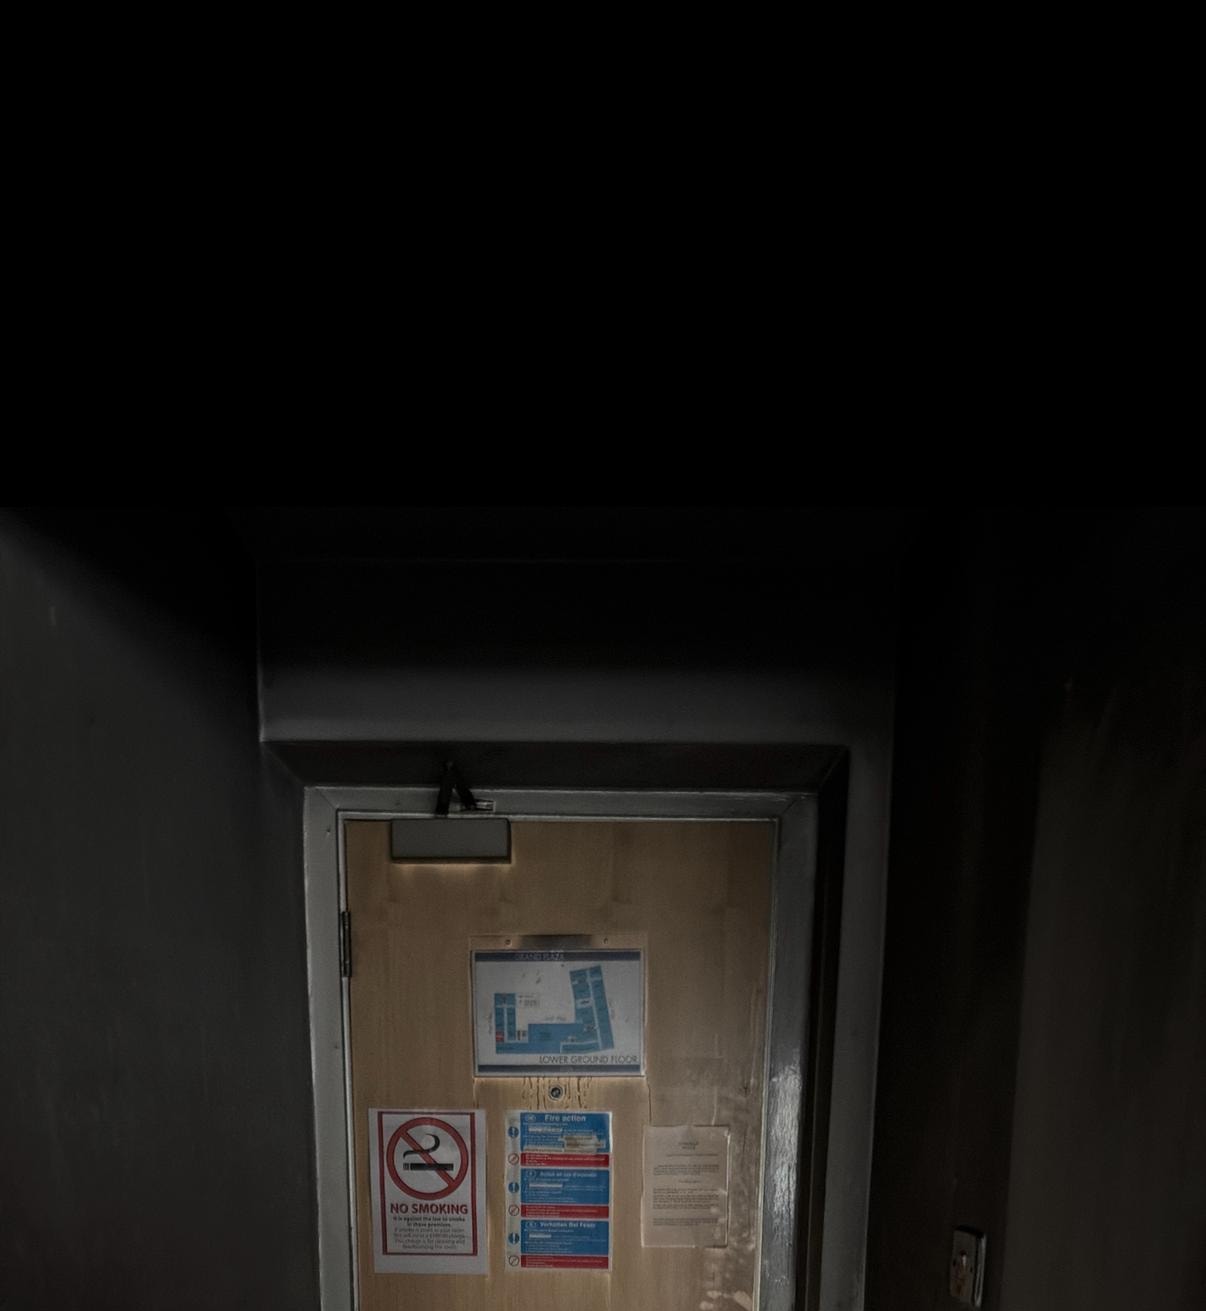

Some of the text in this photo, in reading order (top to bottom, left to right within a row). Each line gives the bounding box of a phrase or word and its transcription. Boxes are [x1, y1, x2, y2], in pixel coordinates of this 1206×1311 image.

[539, 1055, 638, 1064] LOWER GROUND FLOOR
[544, 1114, 587, 1122] Fire action
[390, 1203, 468, 1215] NO SMOKING
